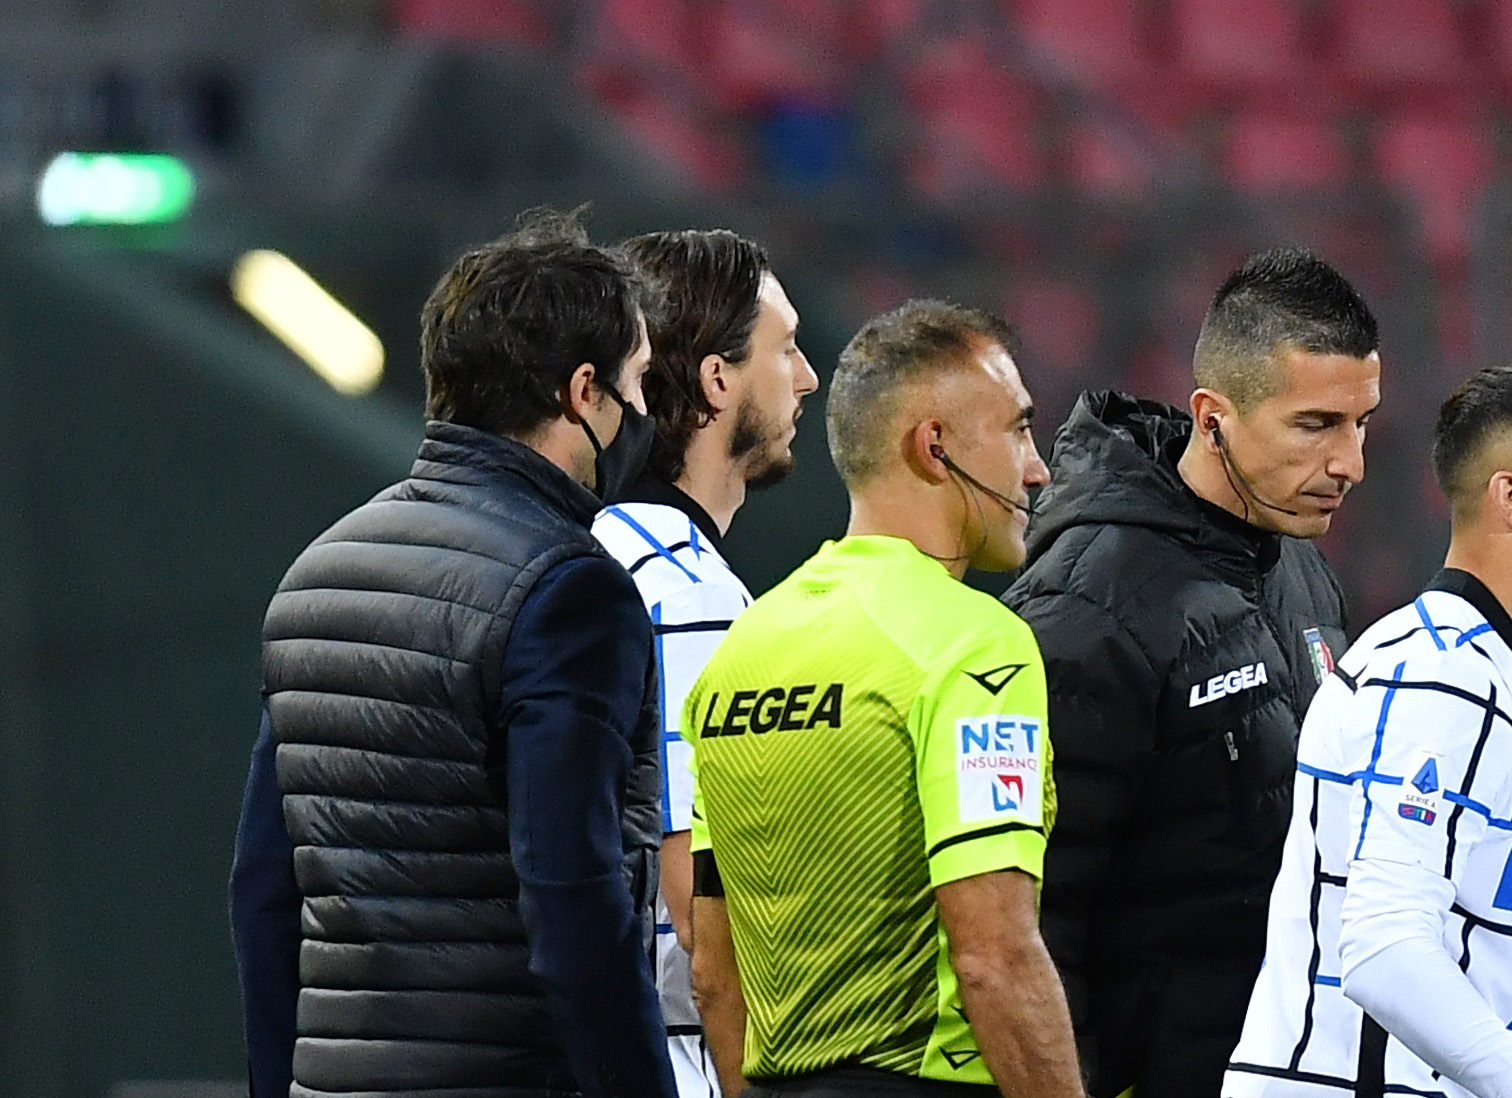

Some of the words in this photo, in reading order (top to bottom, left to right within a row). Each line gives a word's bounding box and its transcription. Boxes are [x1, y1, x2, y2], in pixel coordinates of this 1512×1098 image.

[1188, 662, 1268, 708] LEGEA
[700, 683, 844, 739] LEGEA
[961, 721, 1038, 754] NET
[1405, 794, 1430, 807] SERIE
